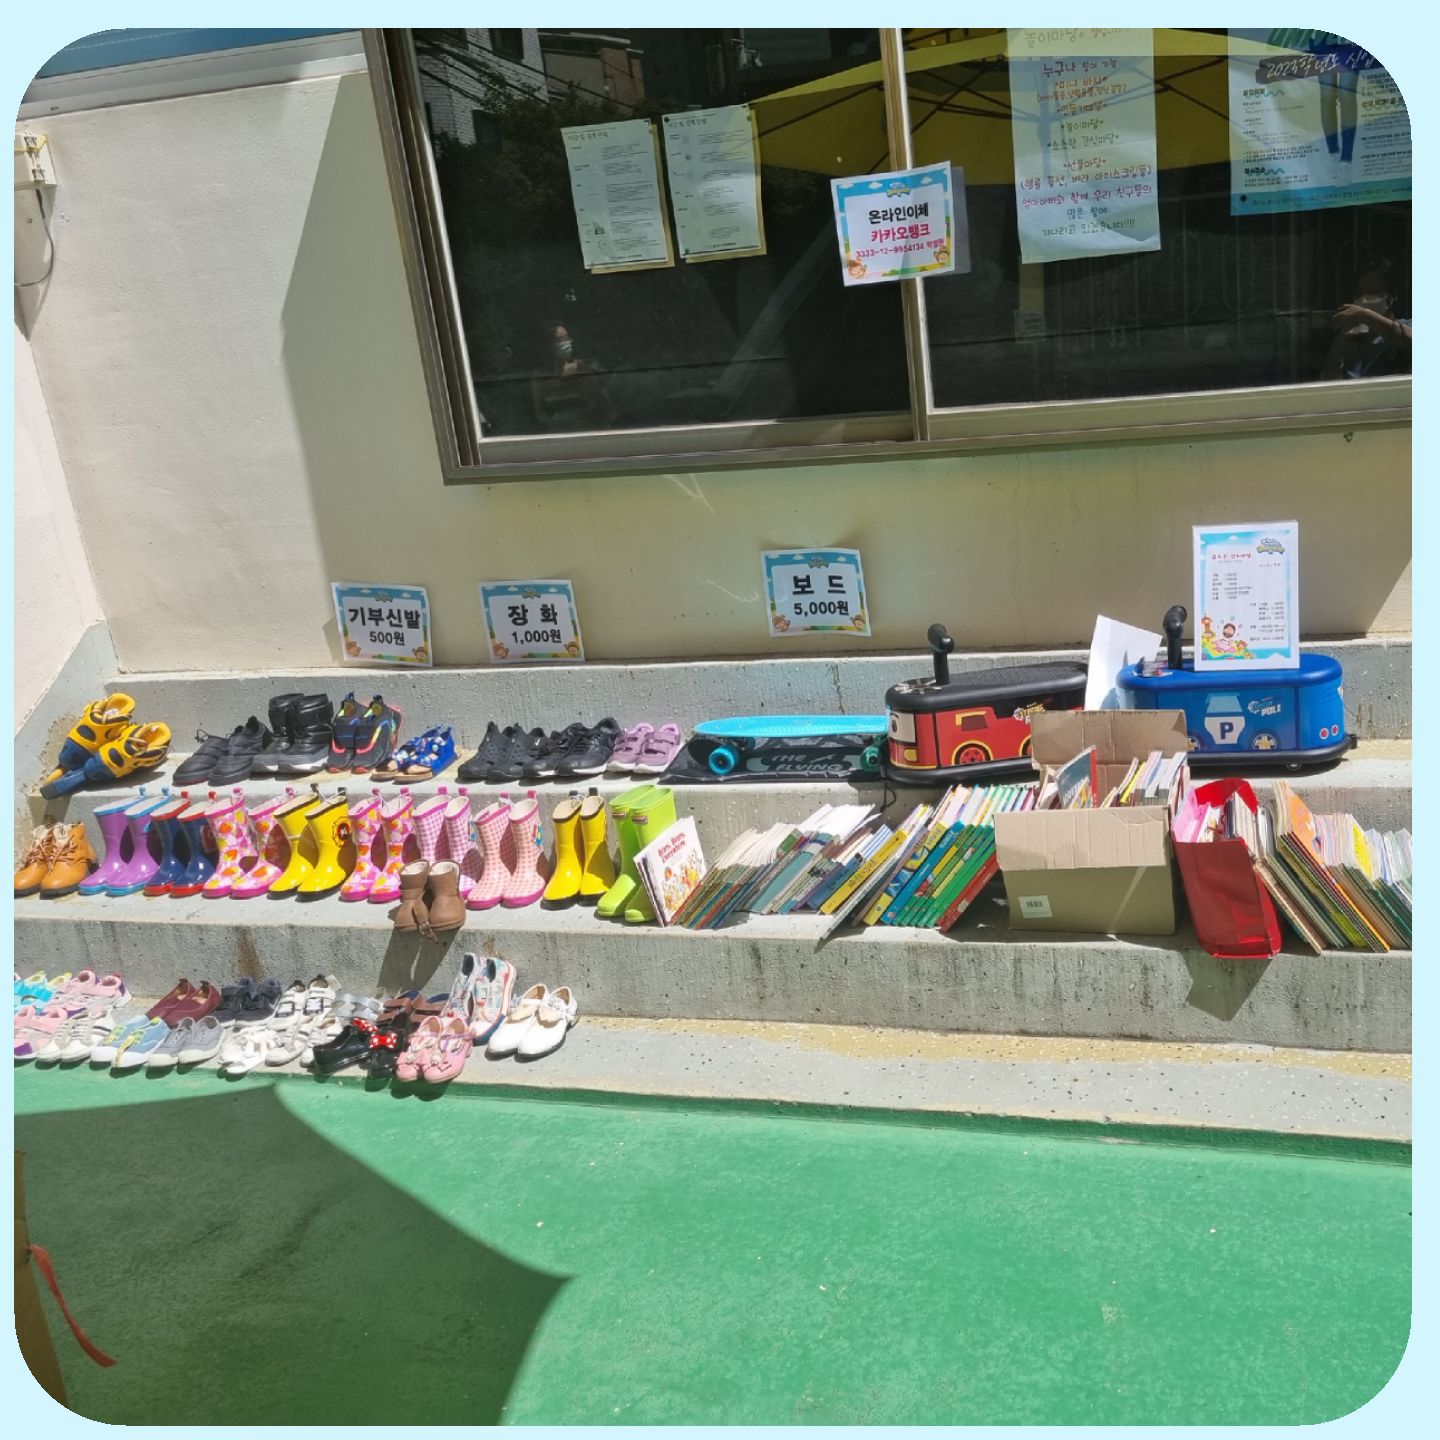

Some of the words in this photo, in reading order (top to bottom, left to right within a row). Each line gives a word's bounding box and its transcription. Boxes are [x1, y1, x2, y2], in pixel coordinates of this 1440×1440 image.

[1043, 61, 1077, 78] 누구나
[868, 202, 929, 224] 온라인이체
[871, 223, 931, 243] 카카오뱅크
[794, 601, 849, 617] 5,000원
[348, 606, 421, 630] 기부신발
[369, 631, 406, 647] 500원
[511, 629, 562, 645] 1,000원
[1220, 722, 1234, 739] P
[771, 754, 804, 762] THE
[775, 763, 844, 772] FLYING
